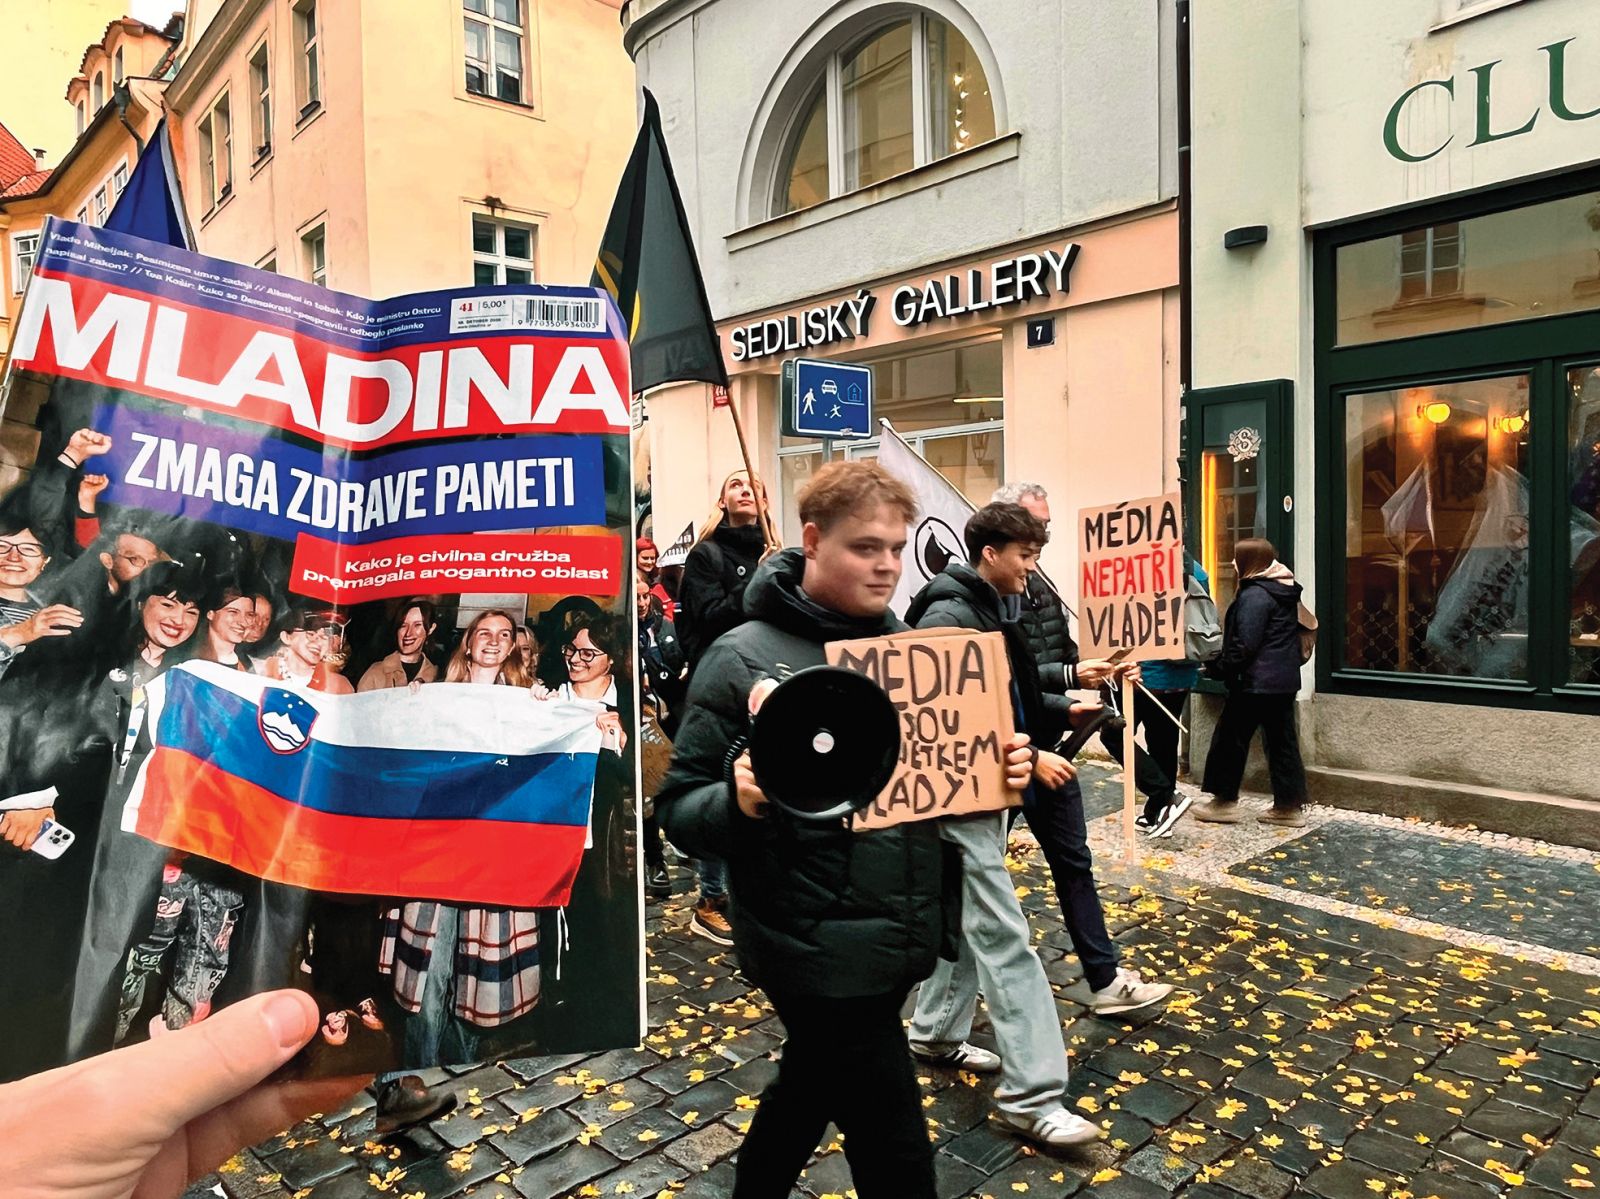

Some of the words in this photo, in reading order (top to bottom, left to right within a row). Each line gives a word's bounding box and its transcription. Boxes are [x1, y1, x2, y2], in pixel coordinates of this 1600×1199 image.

[50, 231, 81, 245] Vlado
[346, 310, 365, 321] Kdo
[365, 315, 375, 324] je
[89, 257, 129, 271] zakon?
[198, 283, 224, 296] Kako
[226, 292, 238, 300] so
[730, 289, 873, 362] SEDLISKÝ
[890, 243, 1078, 326] GALLERY
[459, 302, 473, 312] 41
[1035, 325, 1043, 341] 7
[11, 275, 630, 443] MLADINA
[124, 432, 279, 516] ZMAGA
[286, 467, 428, 533] ZDRAVE
[435, 457, 575, 516] PAMETI
[1085, 501, 1178, 553] MÉDIA
[303, 568, 416, 591] premagala
[419, 566, 537, 580] arogantno
[540, 566, 609, 580] oblast
[345, 558, 392, 574] Kako
[395, 553, 414, 568] je
[418, 550, 486, 563] civilna
[490, 550, 571, 563] družba
[1083, 540, 1181, 598] NEPATŘÍ
[1086, 591, 1182, 648] VLÁDĚ!
[901, 706, 959, 744] SOU
